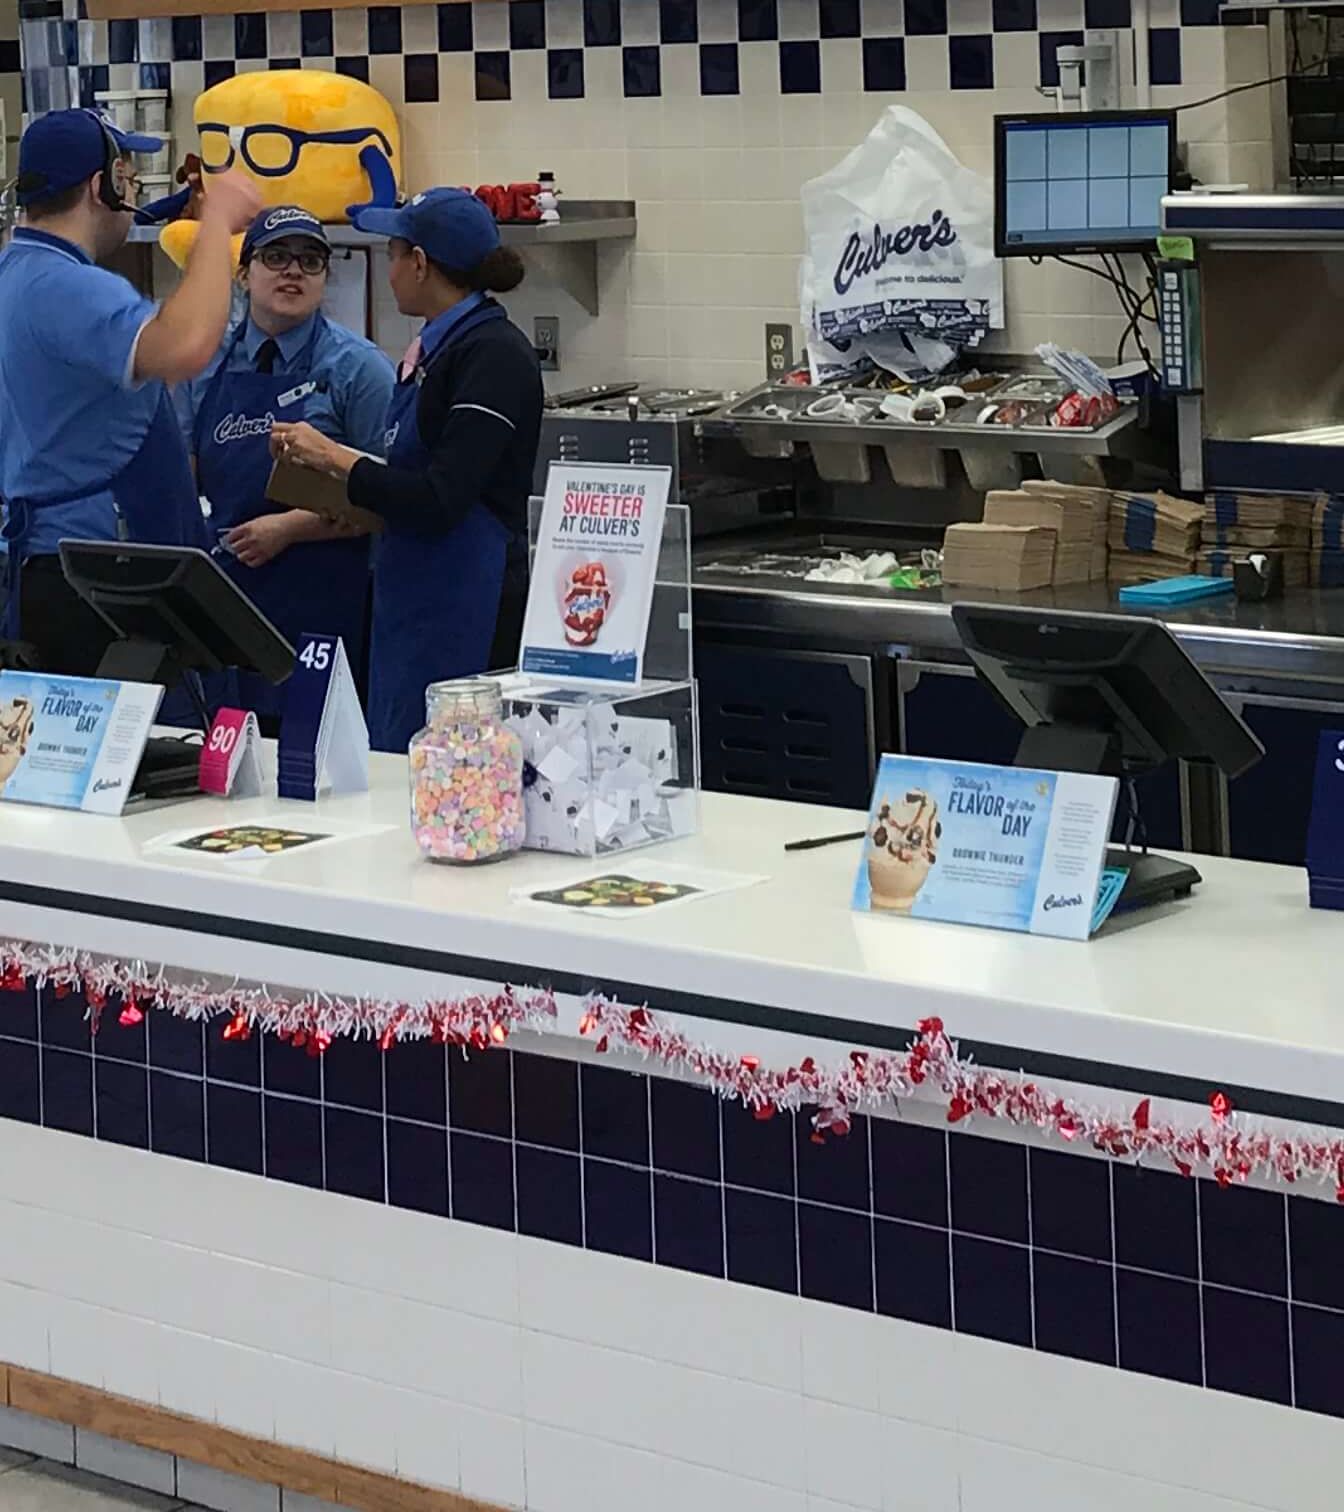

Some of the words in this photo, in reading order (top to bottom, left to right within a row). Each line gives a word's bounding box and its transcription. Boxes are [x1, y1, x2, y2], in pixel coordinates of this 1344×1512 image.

[834, 209, 957, 295] Culver's
[904, 275, 916, 284] to
[917, 274, 963, 285] delicious.
[213, 411, 275, 444] Culver's
[566, 480, 619, 494] VALENTINE'S
[619, 484, 635, 495] DAY
[637, 485, 646, 496] IS
[563, 493, 643, 519] SWEETER
[559, 516, 576, 533] AT
[580, 516, 640, 537] CULVER'S
[299, 640, 331, 670] 45
[41, 697, 83, 717] FLAVOR
[75, 717, 99, 733] DAY
[209, 725, 236, 754] 90
[92, 778, 122, 793] Culver's
[953, 776, 992, 793] Today's
[948, 790, 1005, 817] FLAVOR
[1005, 800, 1019, 813] of
[1020, 800, 1036, 812] the
[1002, 815, 1032, 838] DAY
[952, 847, 986, 863] BROWNIE
[989, 850, 1025, 866] THUNDER
[1043, 893, 1084, 912] Culver's
